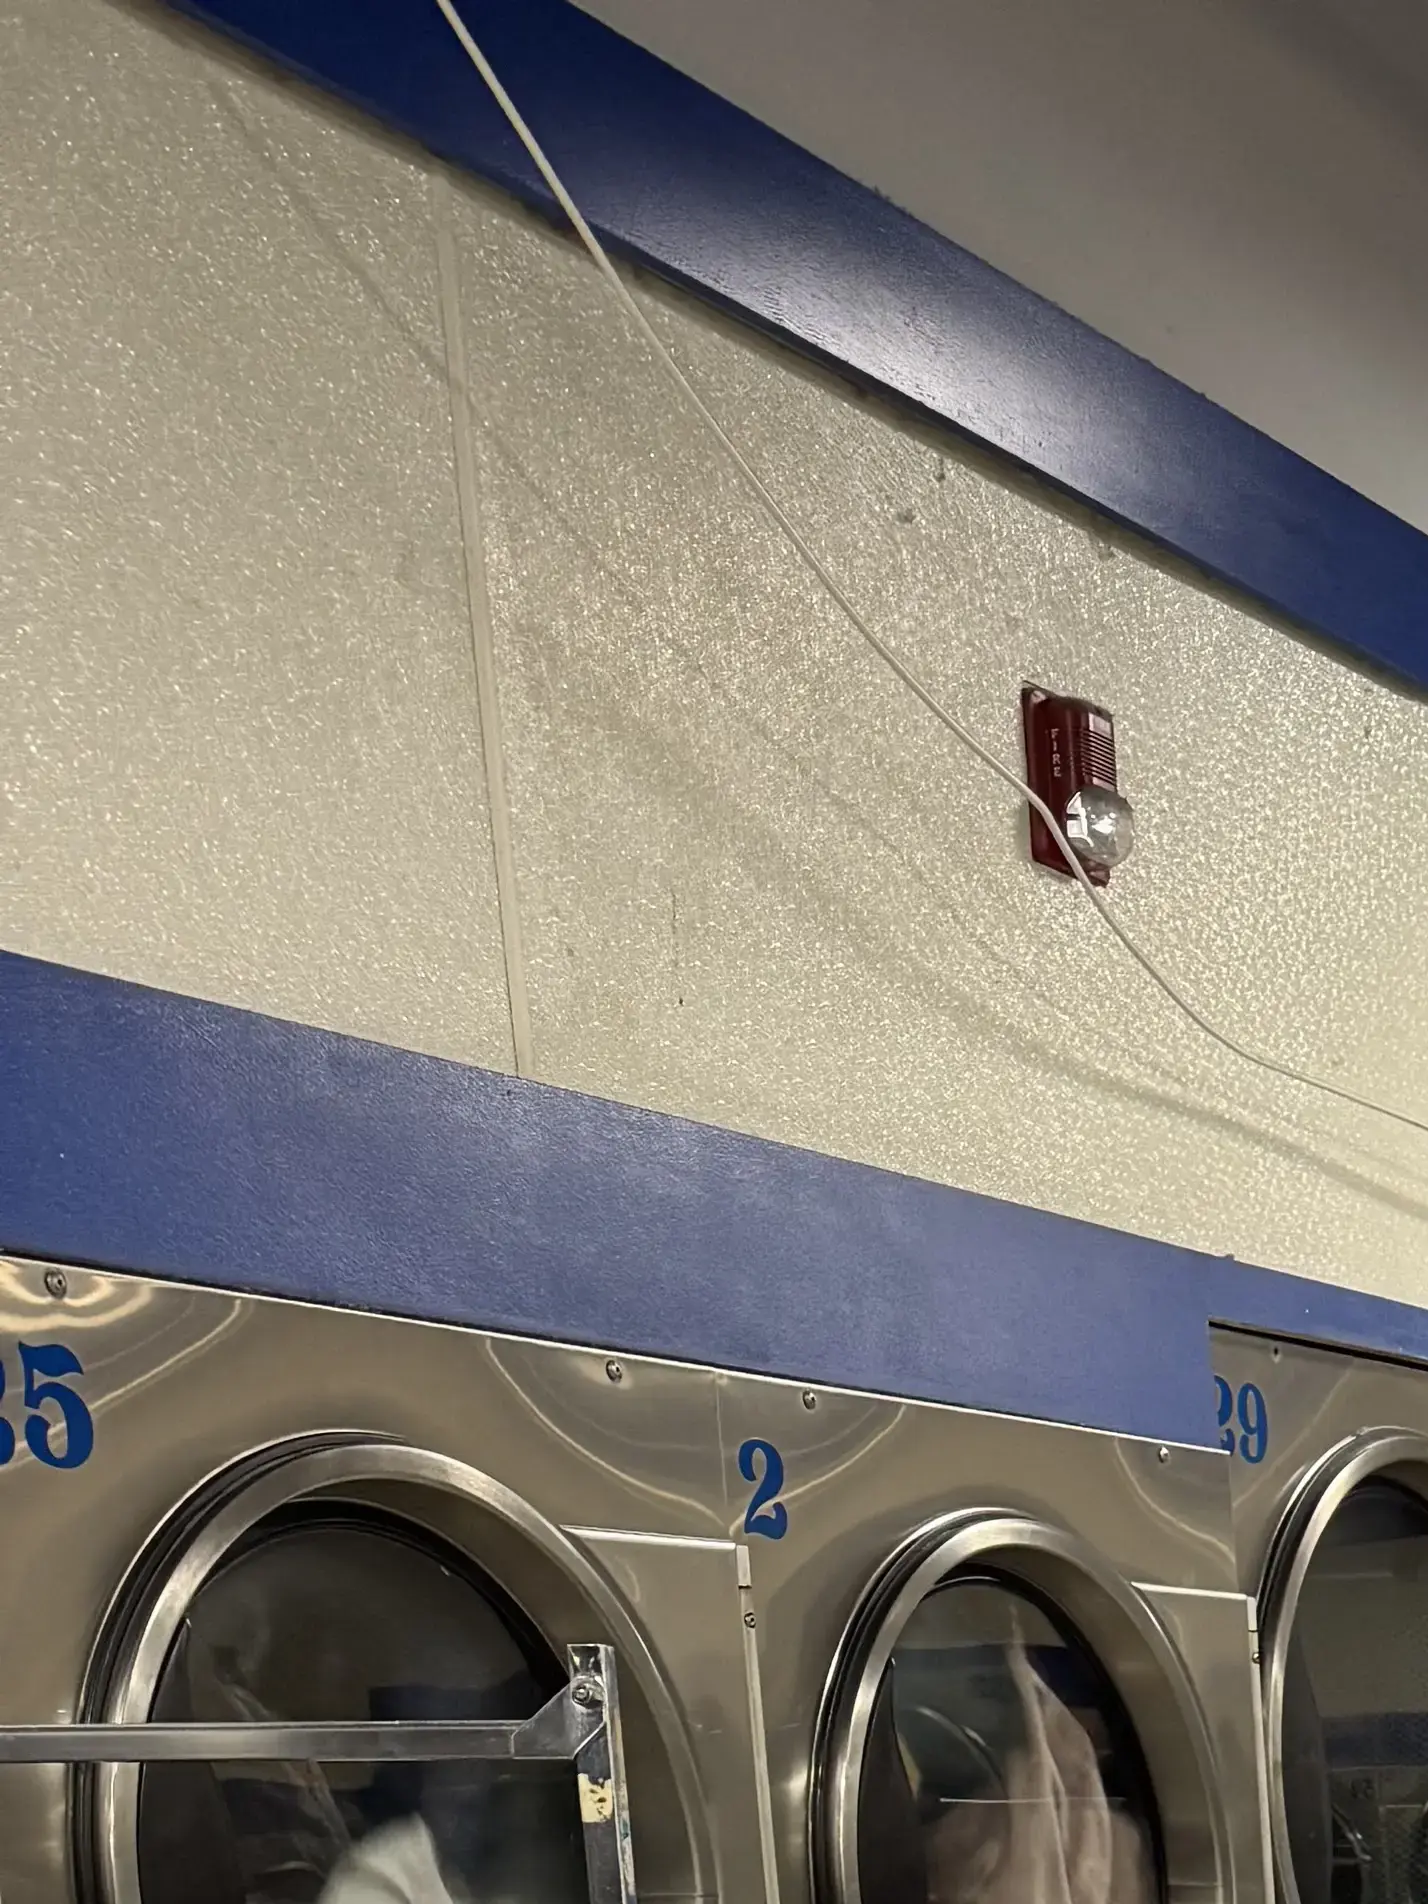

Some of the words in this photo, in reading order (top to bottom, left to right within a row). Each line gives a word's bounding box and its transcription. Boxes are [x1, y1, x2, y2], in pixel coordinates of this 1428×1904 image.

[1050, 728, 1062, 777] FIRE
[0, 1341, 94, 1469] 5
[738, 1439, 789, 1540] 2
